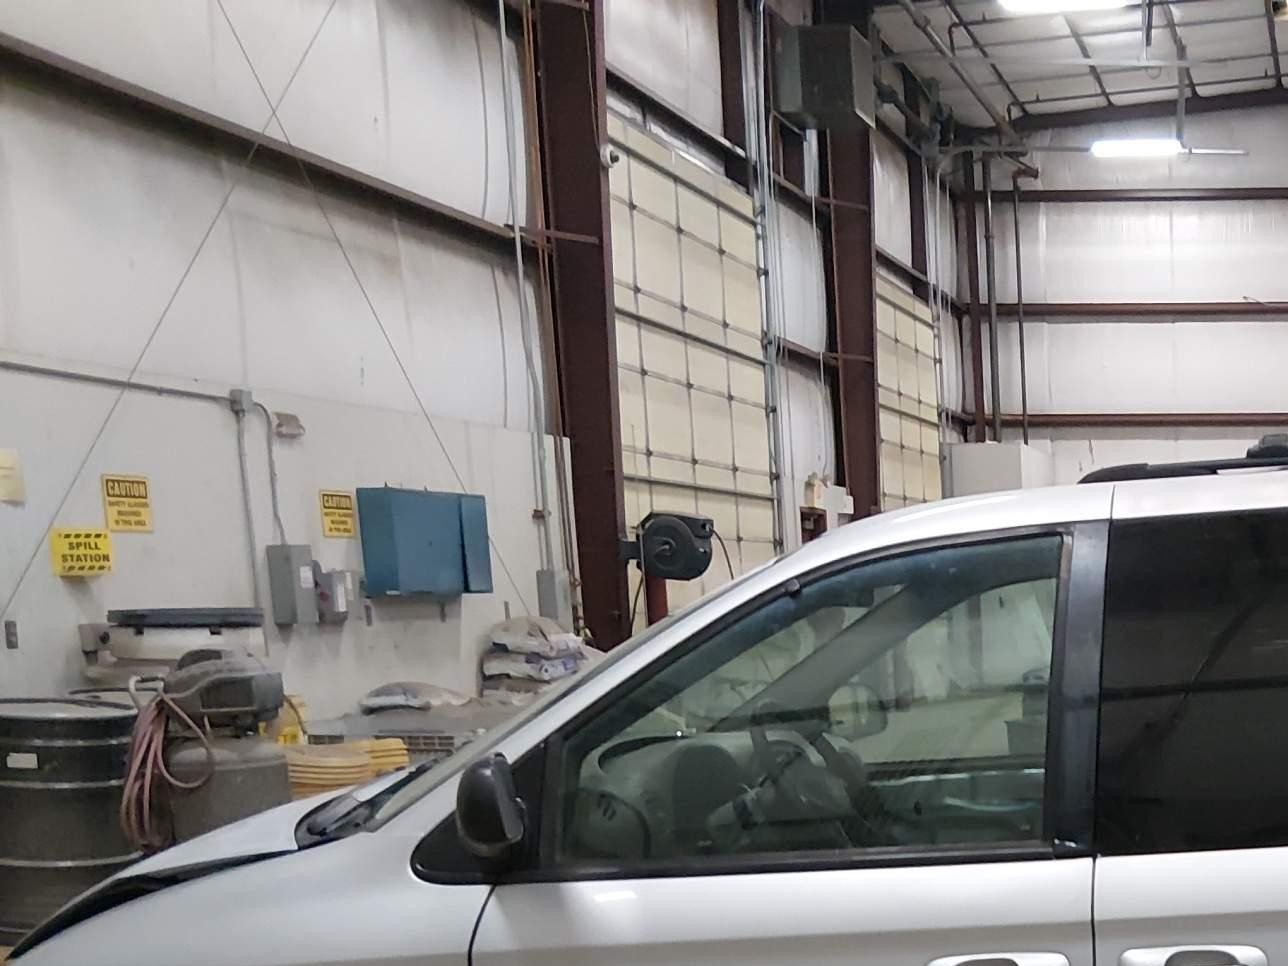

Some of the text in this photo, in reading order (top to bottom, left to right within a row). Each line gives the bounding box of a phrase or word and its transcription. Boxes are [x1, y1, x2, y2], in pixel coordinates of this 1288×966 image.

[107, 481, 146, 498] CAUTION
[68, 541, 101, 551] SPILL
[61, 553, 110, 563] STATION
